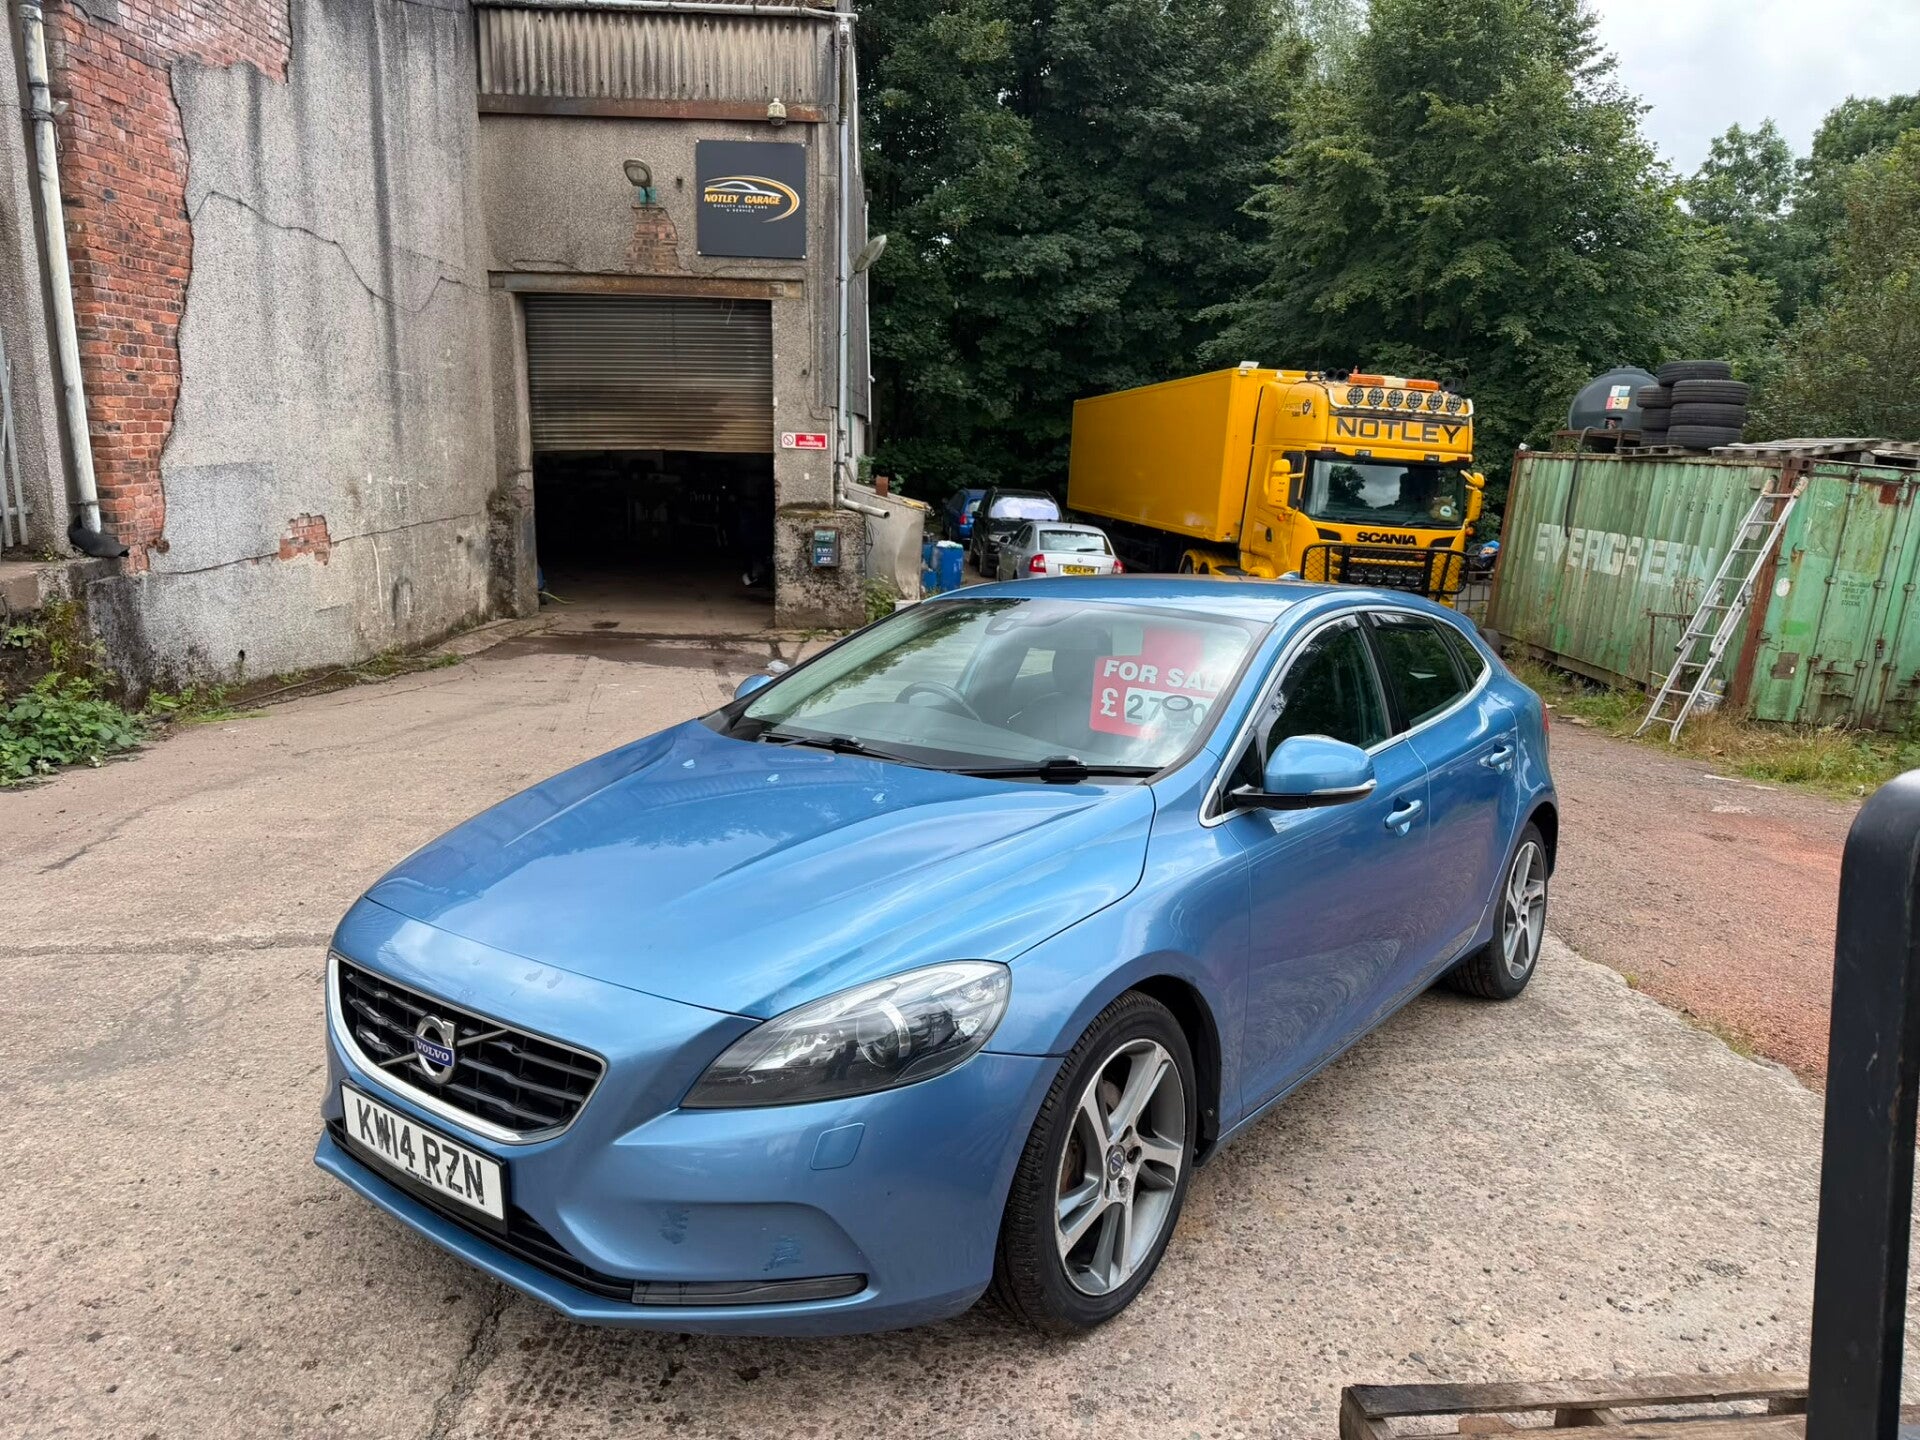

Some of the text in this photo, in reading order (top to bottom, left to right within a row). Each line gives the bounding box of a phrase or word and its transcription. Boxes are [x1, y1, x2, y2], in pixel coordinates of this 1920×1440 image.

[704, 194, 781, 205] NOTLEY GARAGE
[1336, 417, 1462, 445] NOTLEY
[1356, 531, 1417, 546] SCANIA
[1103, 659, 1219, 692] FOR SAL
[416, 1040, 449, 1062] VOLVO
[356, 1098, 485, 1205] KW14 RZN
